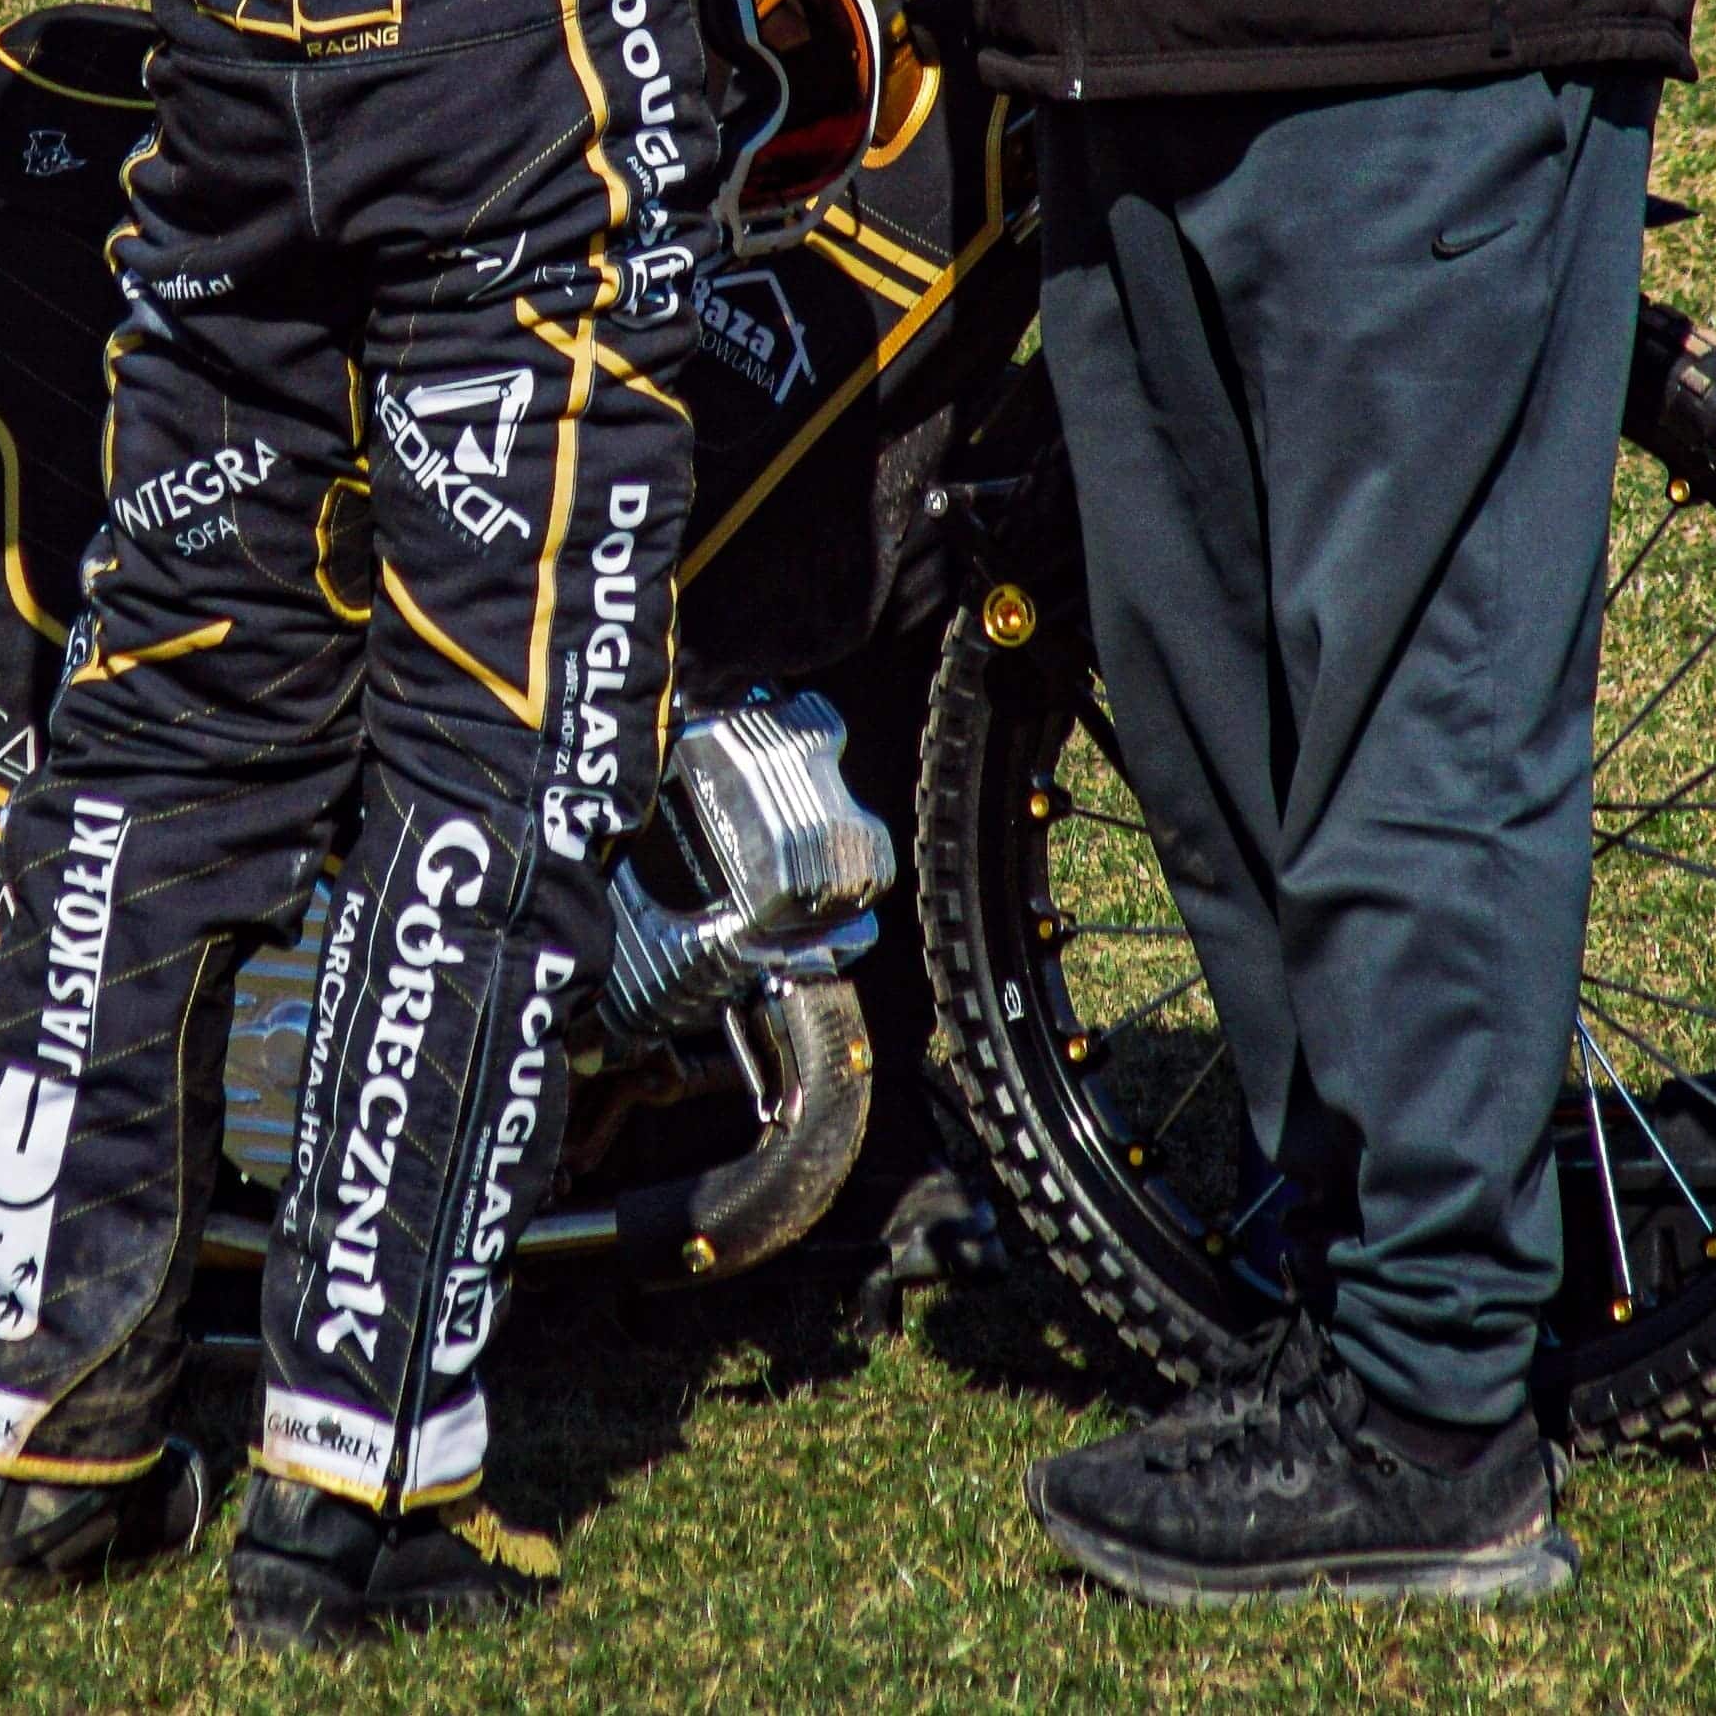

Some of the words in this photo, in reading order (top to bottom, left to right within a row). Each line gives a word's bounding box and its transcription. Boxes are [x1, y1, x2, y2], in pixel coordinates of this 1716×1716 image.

[306, 27, 401, 58] RACING
[114, 436, 280, 539] INTEGRA
[175, 514, 240, 557] SOFA
[577, 483, 651, 786] DOUGLAS
[36, 797, 125, 1078] JASKÓŁKI
